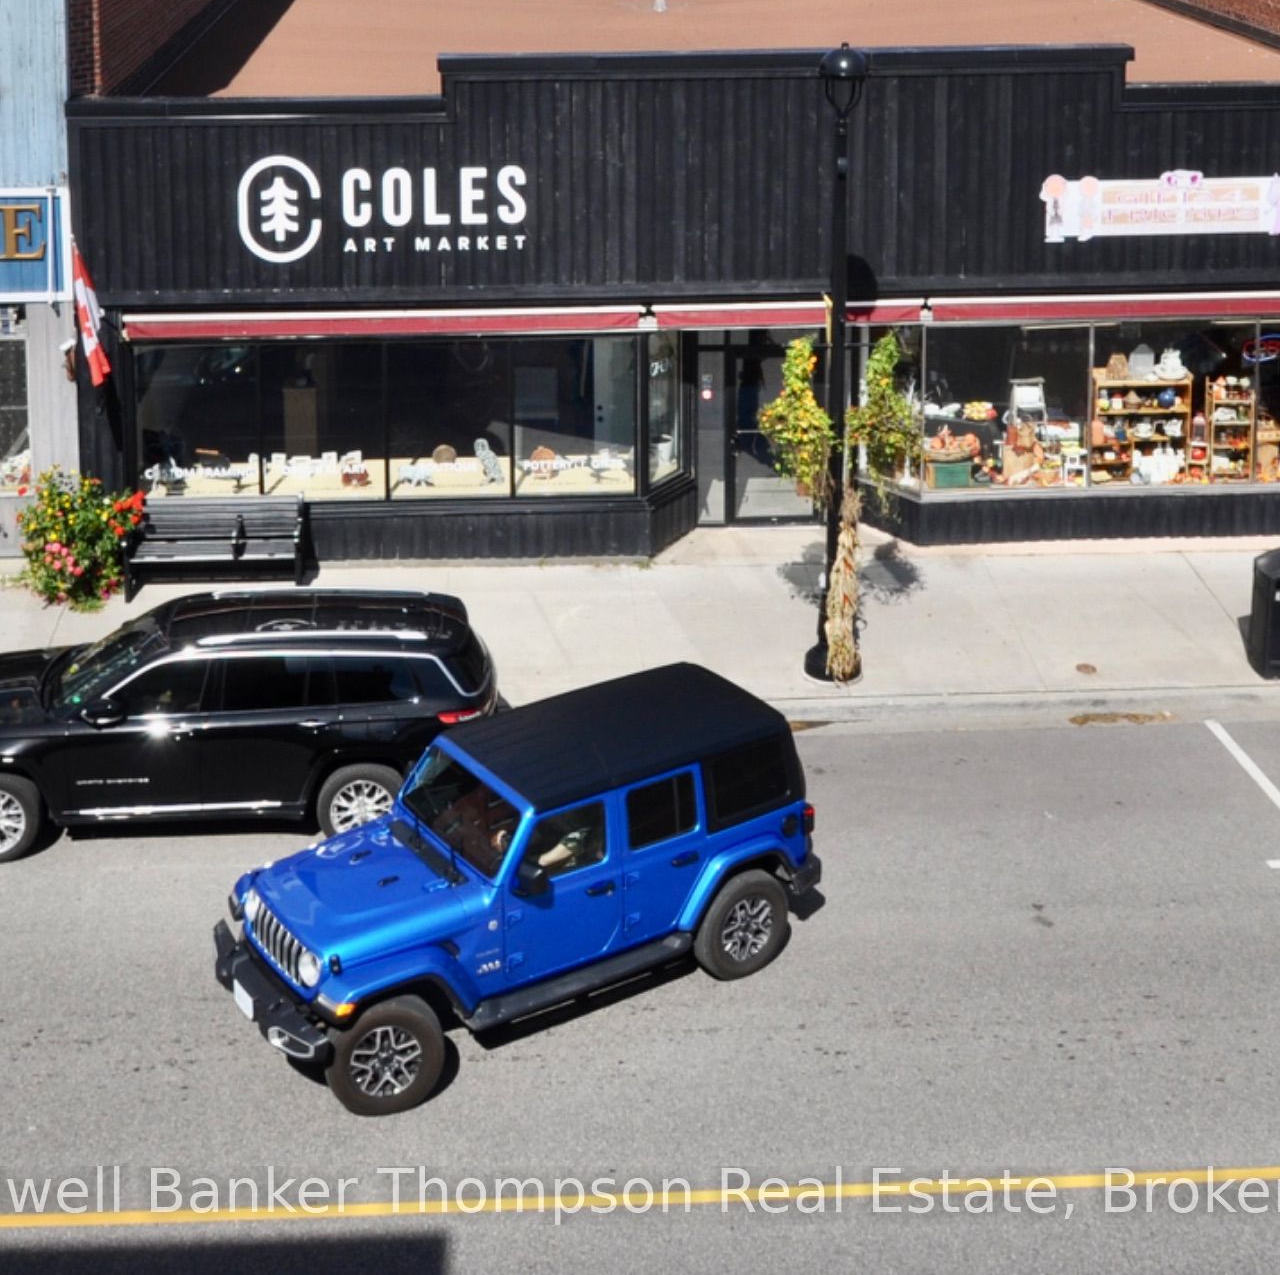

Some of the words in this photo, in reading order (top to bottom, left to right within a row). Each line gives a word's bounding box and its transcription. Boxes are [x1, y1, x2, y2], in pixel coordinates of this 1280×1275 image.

[341, 164, 528, 228] COLES
[343, 236, 397, 253] ART
[414, 234, 528, 253] MARKET
